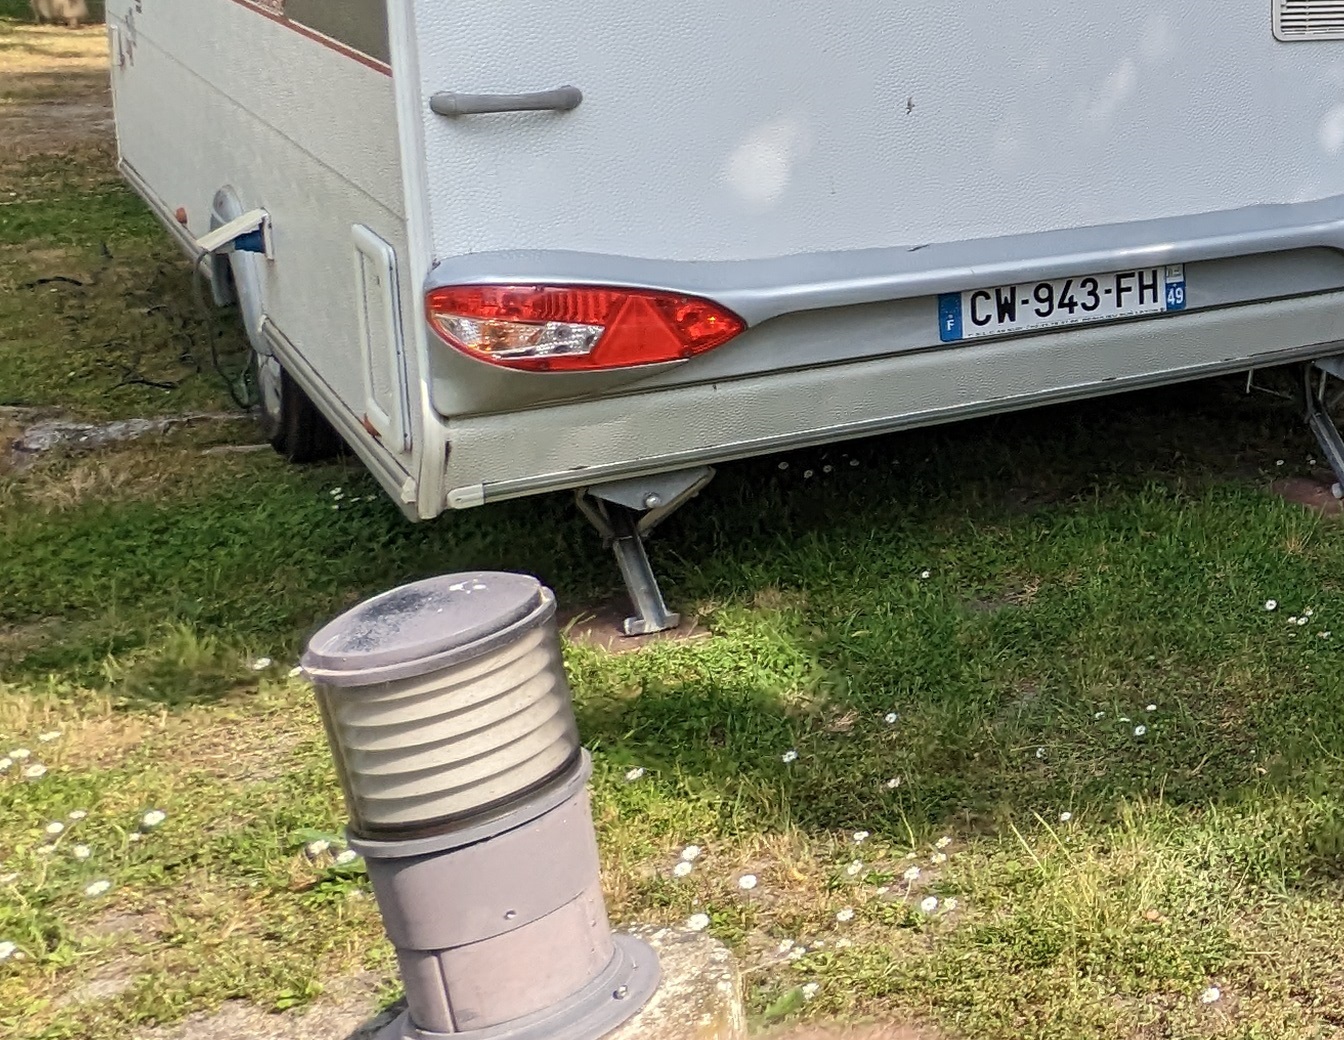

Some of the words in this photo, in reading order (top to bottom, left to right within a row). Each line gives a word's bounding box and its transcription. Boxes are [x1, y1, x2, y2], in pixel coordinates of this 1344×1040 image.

[946, 319, 955, 332] F
[970, 268, 1158, 327] CW-943-FH
[1167, 287, 1184, 305] 49
